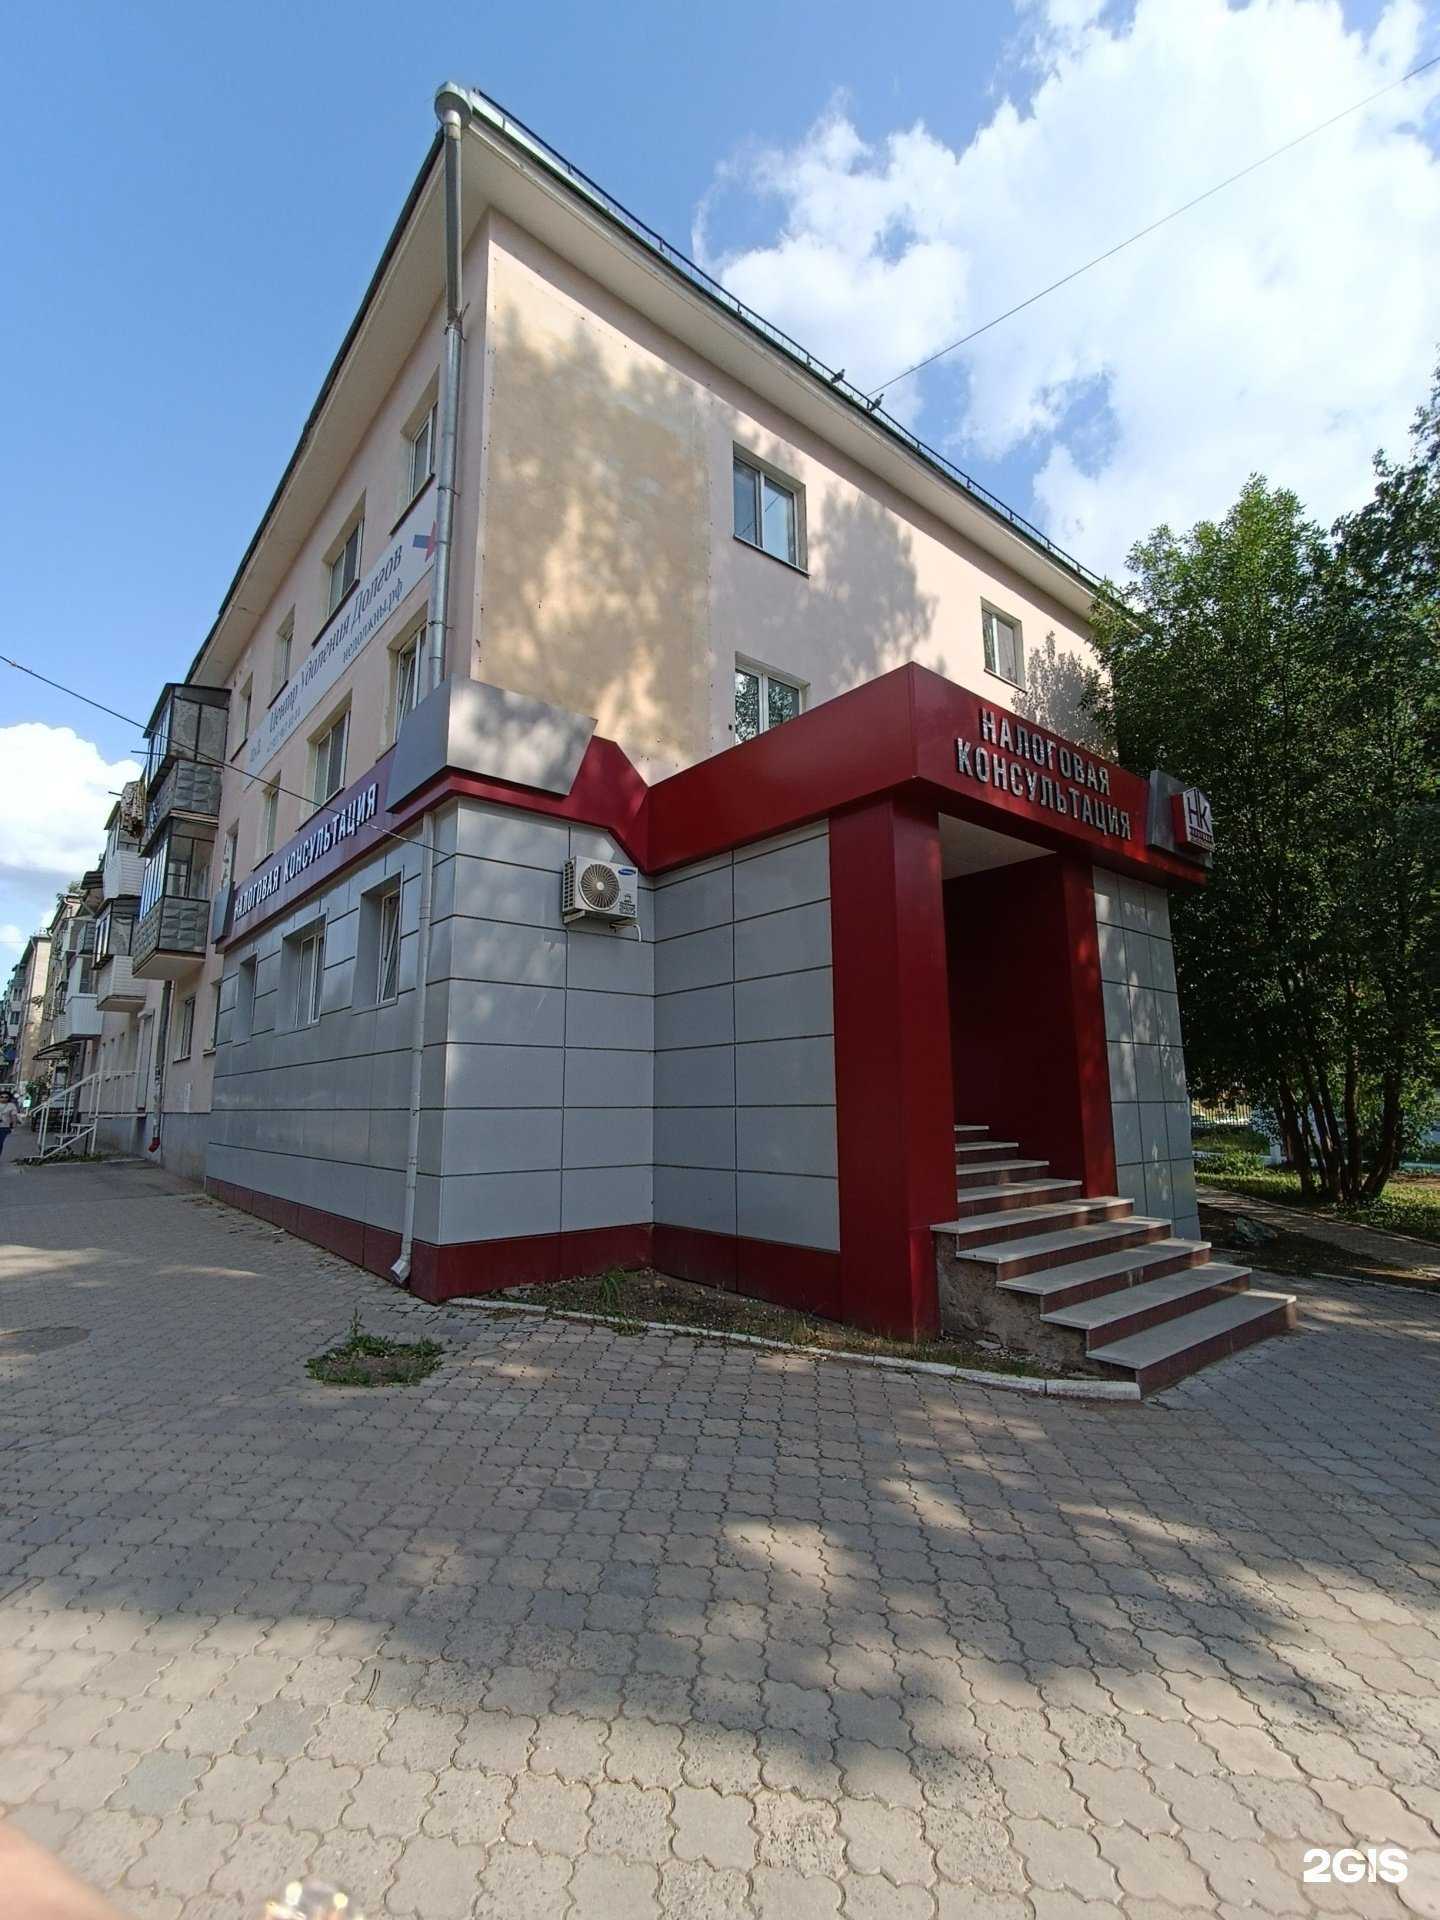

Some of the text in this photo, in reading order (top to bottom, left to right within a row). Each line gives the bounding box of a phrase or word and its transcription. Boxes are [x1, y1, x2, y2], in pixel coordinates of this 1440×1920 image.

[349, 544, 403, 635] Долгов
[957, 737, 1131, 841] КОНСУЛЬТАЦИЯ
[981, 707, 1111, 796] НАЛОГОВАЯ
[233, 783, 378, 923] НАЛОГОВАЯ КОНСУЛЬТАЦИЯ
